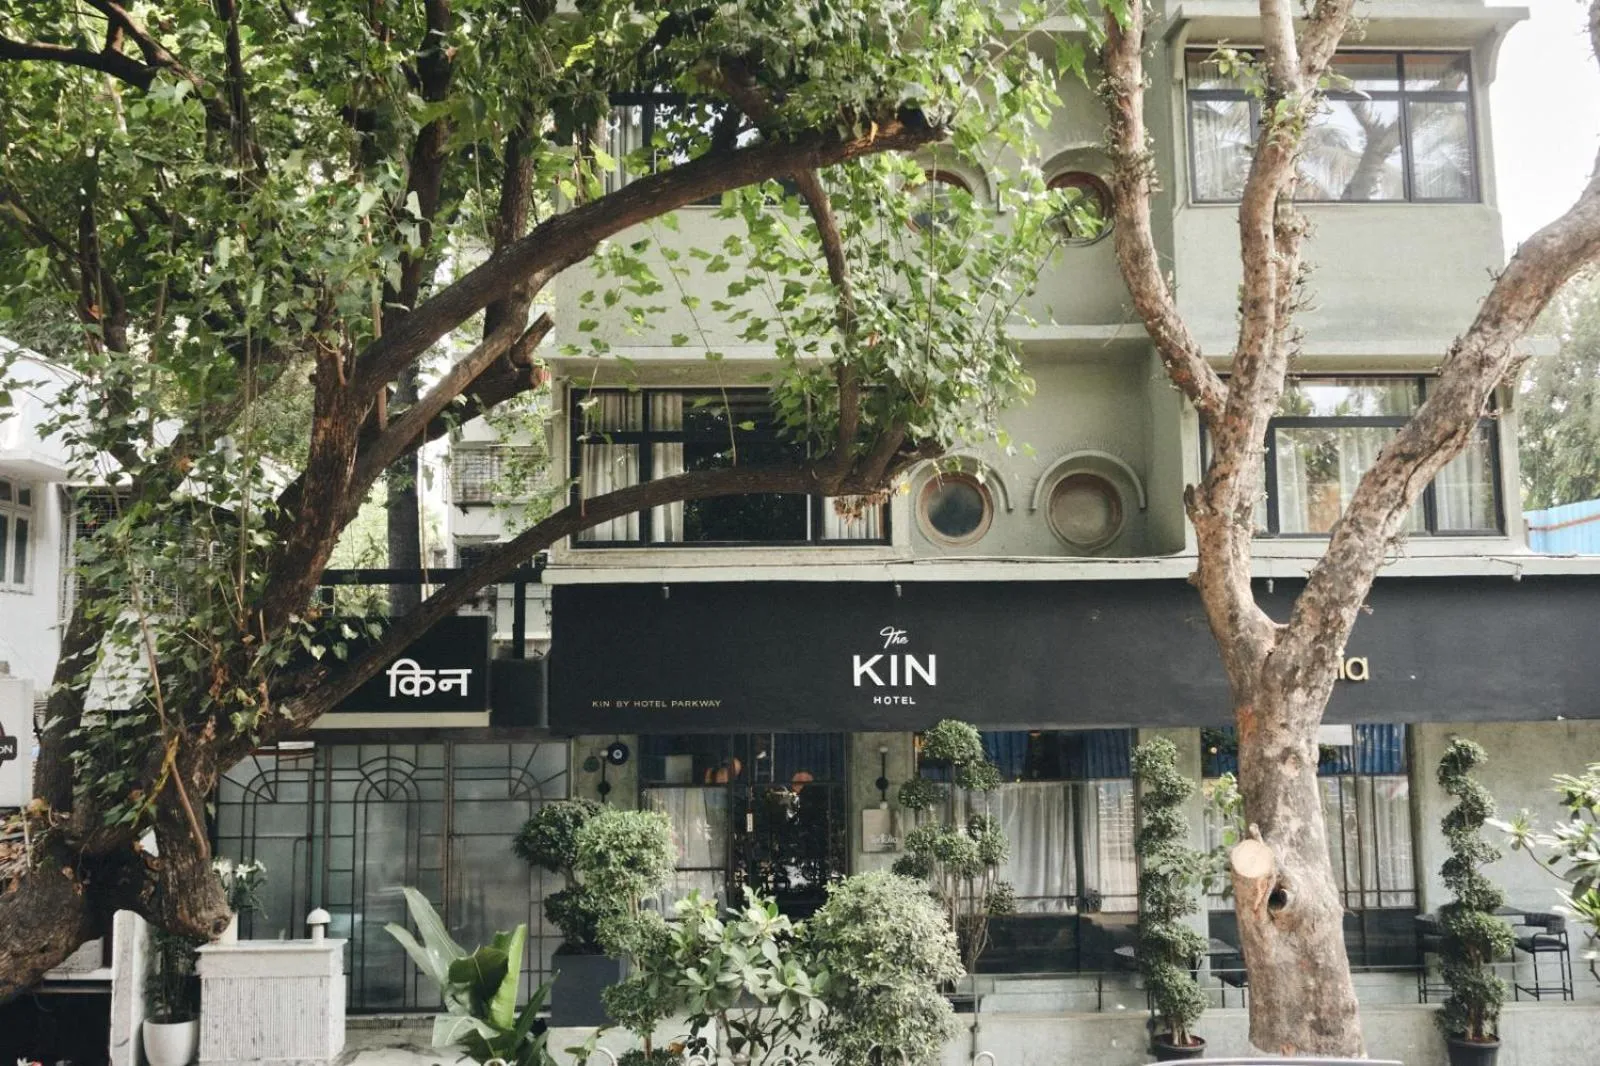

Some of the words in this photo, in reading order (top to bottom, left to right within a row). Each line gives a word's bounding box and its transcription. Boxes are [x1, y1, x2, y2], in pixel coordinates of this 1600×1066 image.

[880, 626, 909, 649] The
[385, 658, 473, 697] किन
[852, 654, 937, 687] KIN
[592, 700, 610, 708] KIN
[615, 700, 630, 708] BY
[633, 700, 667, 708] HOTEL
[671, 700, 721, 708] PARKWAY
[873, 696, 917, 705] HOTEL
